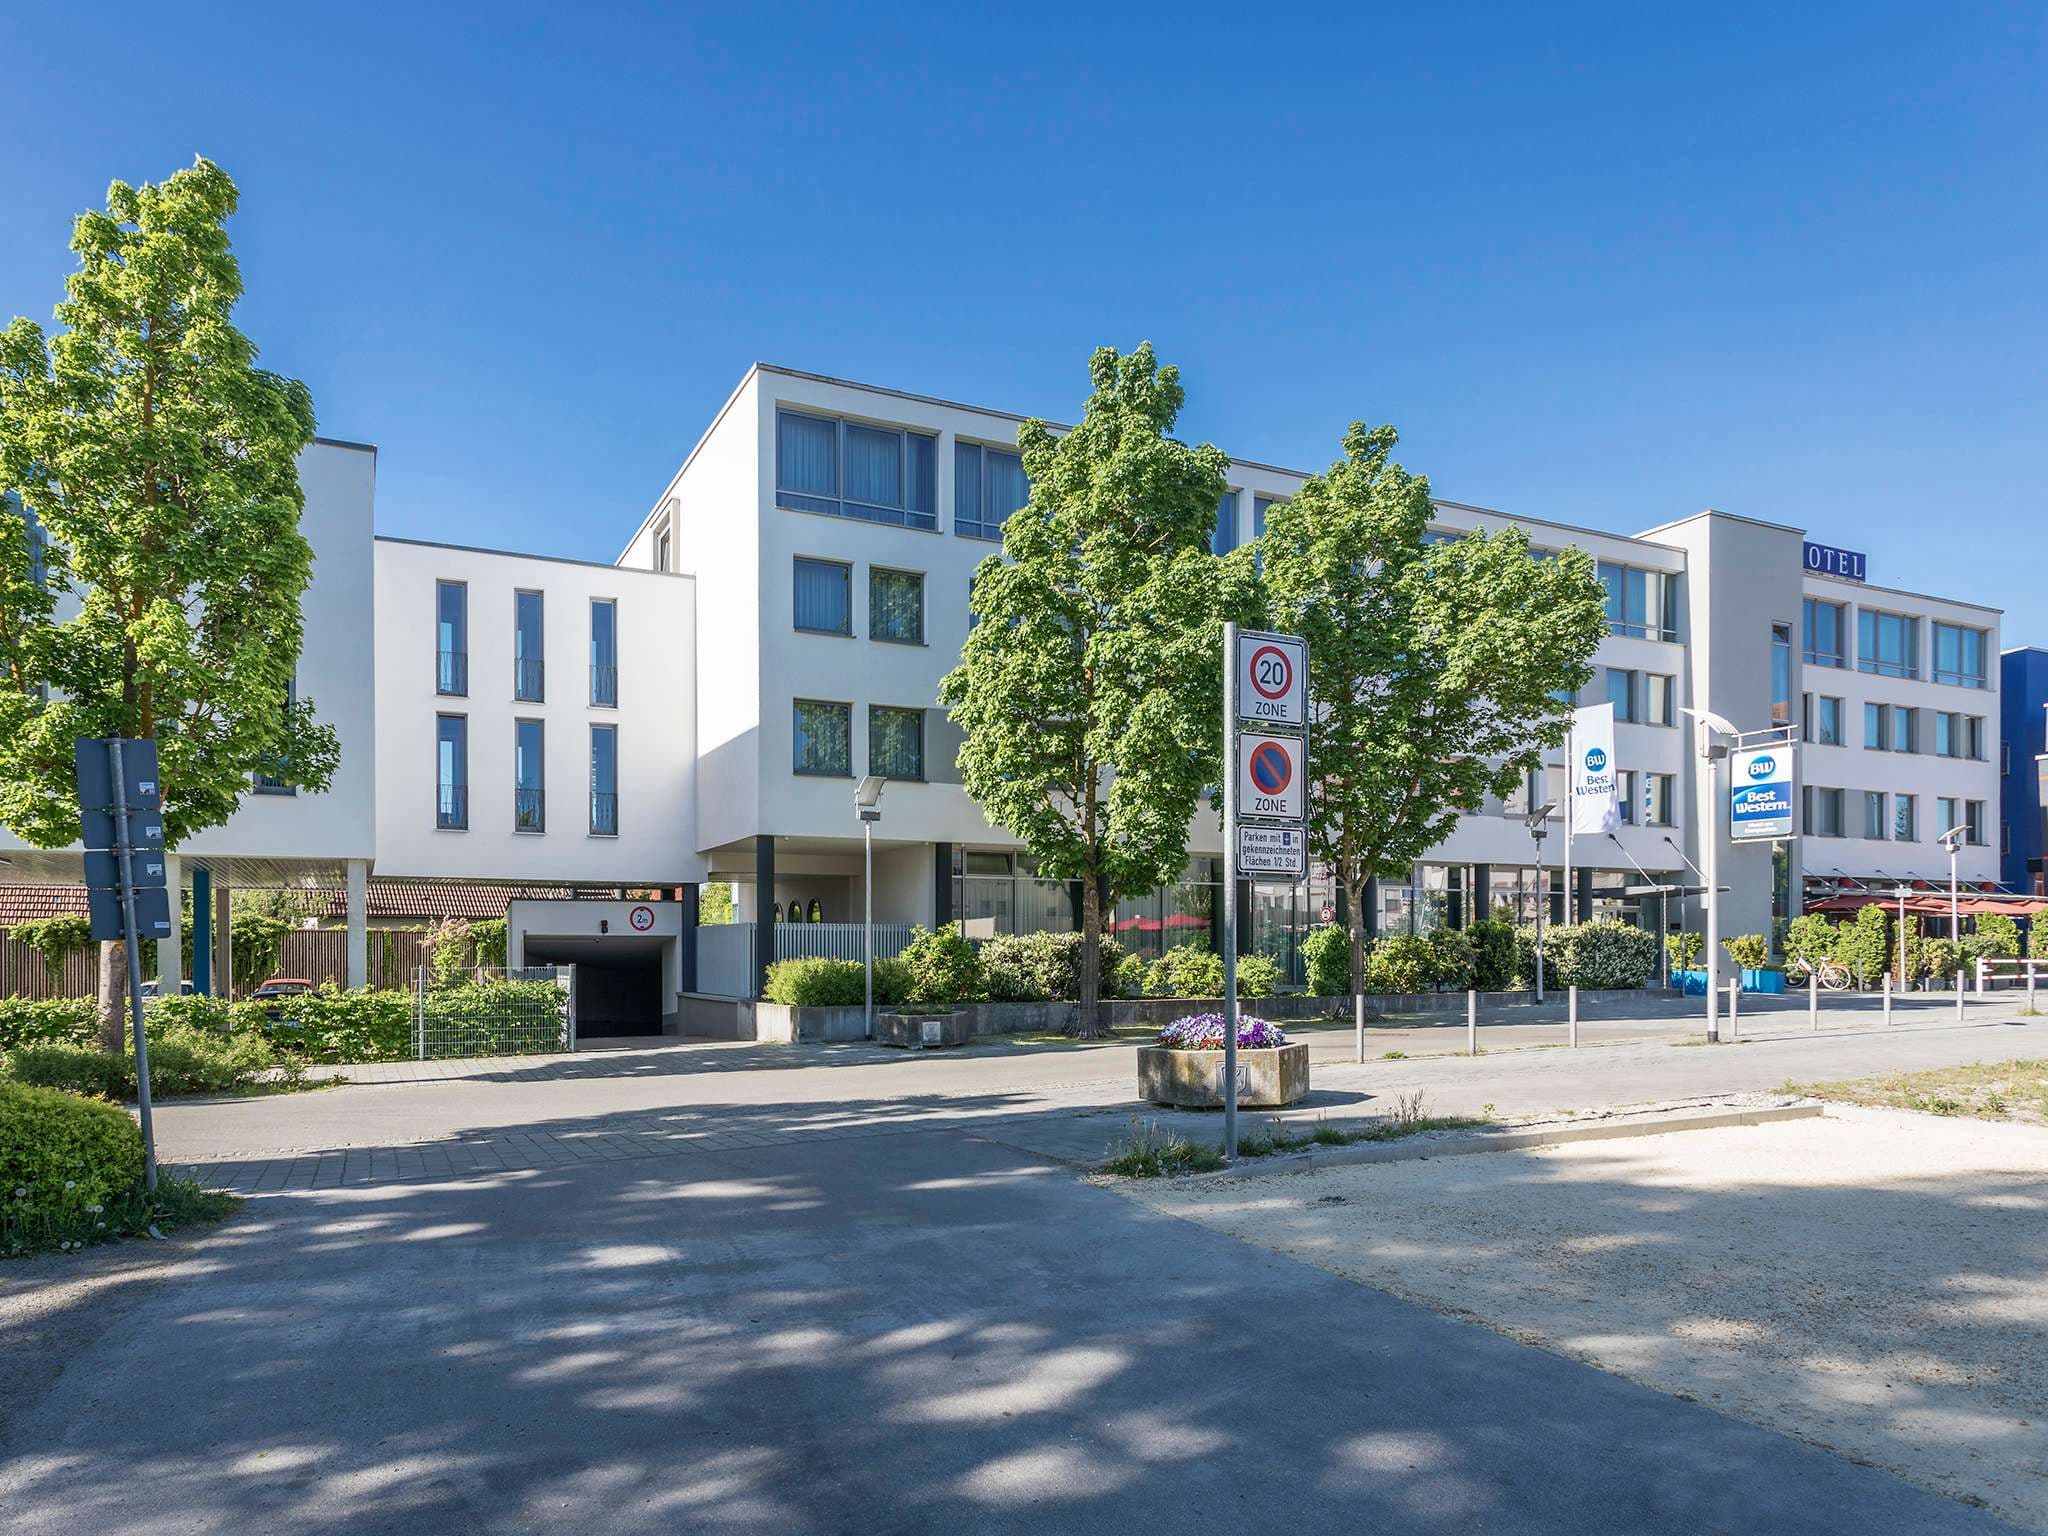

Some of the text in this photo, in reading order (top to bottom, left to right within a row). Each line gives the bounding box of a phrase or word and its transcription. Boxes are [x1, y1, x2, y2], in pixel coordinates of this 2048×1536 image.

[1808, 545, 1863, 577] OTEL
[1260, 660, 1284, 686] 20
[1255, 701, 1288, 718] ZONE
[1587, 754, 1606, 768] BW
[1749, 761, 1776, 776] BW
[1586, 775, 1609, 785] Best
[1747, 790, 1776, 803] Best
[1255, 797, 1288, 813] ZONE
[1244, 831, 1299, 844] Parken mit in
[1242, 844, 1301, 856] gekennzeichneten
[1245, 855, 1271, 866] Flächen
